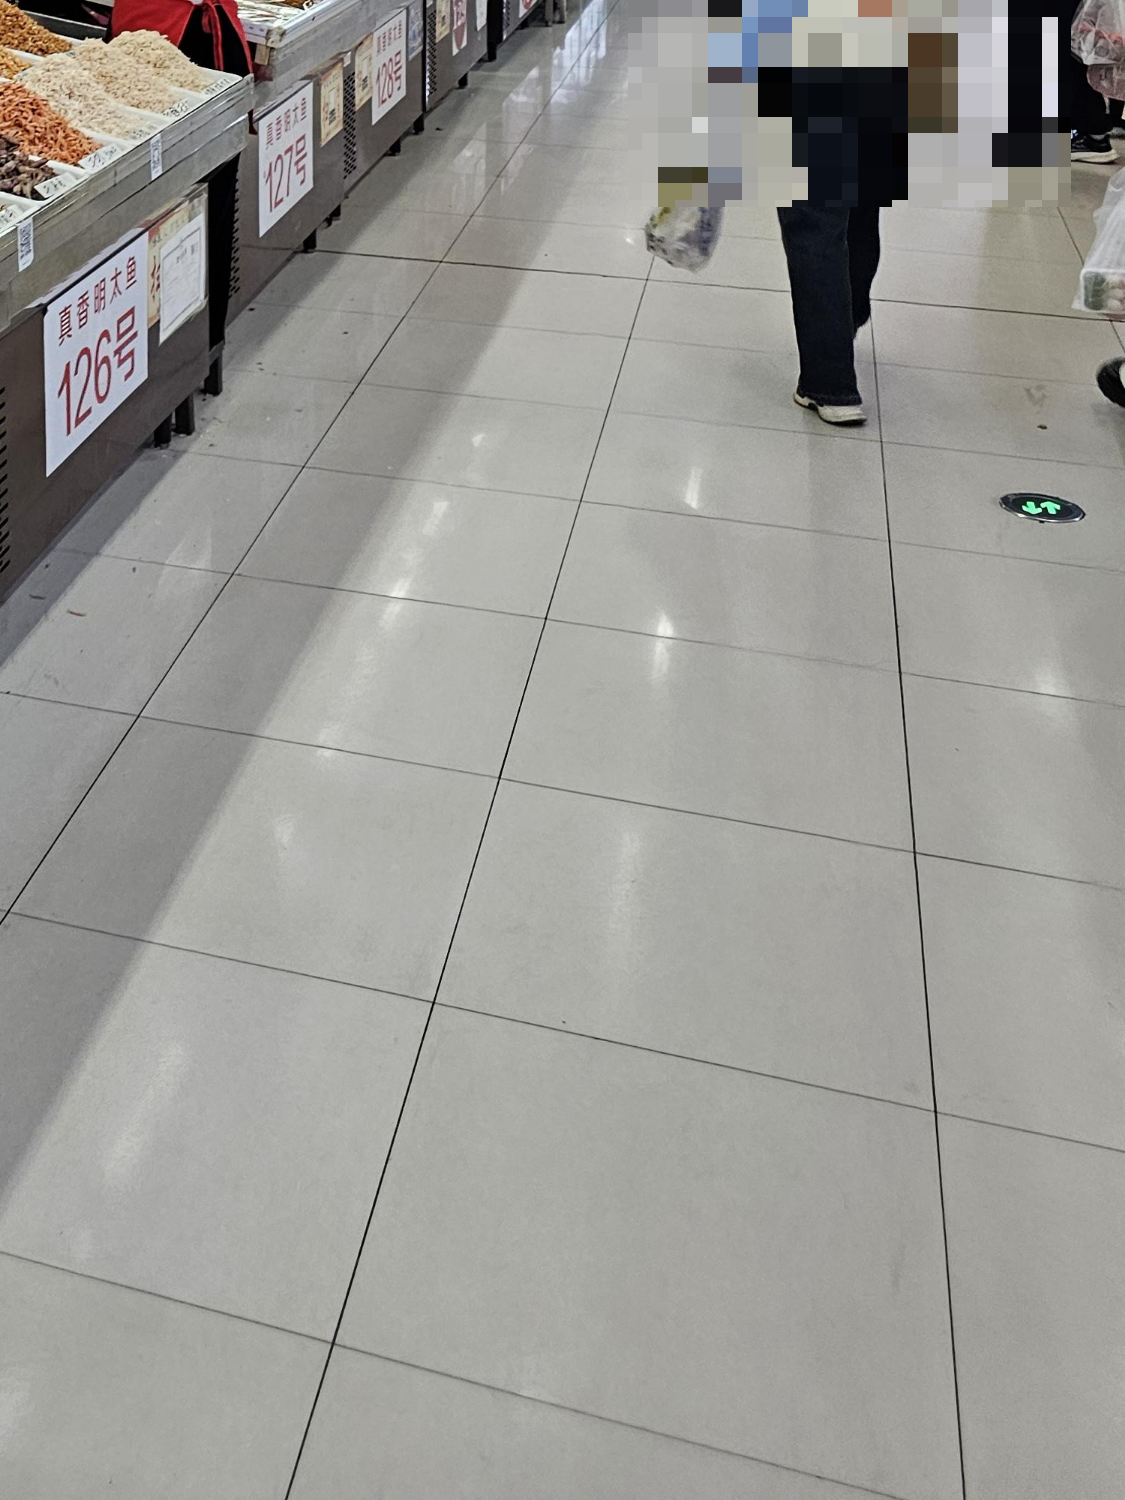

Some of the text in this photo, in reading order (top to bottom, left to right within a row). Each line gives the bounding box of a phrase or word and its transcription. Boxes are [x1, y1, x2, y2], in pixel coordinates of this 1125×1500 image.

[375, 49, 403, 109] 128号
[265, 133, 308, 214] 127号
[58, 255, 138, 346] 真香明太鱼
[58, 305, 137, 437] 126号
